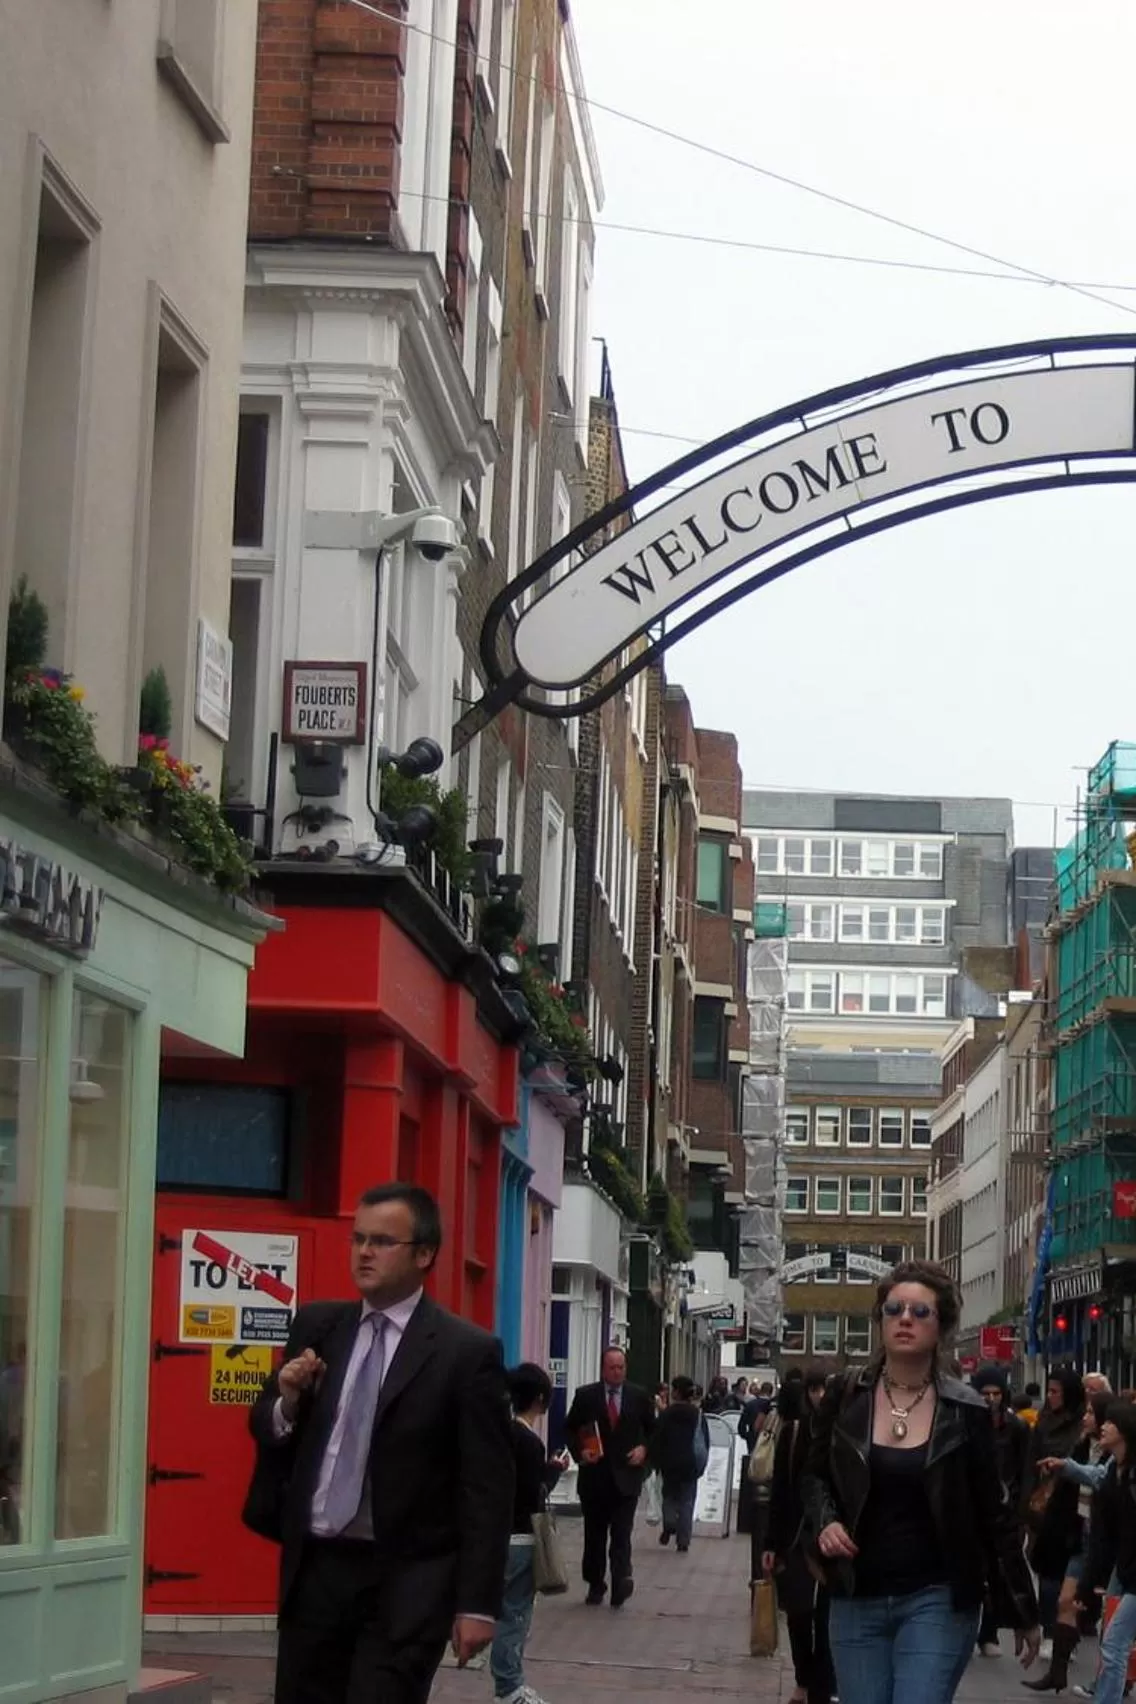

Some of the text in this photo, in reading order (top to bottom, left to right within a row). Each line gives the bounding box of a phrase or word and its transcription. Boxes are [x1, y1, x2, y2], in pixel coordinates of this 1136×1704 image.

[600, 433, 887, 606] WELCOME
[930, 402, 1011, 453] TO
[294, 685, 356, 706] FOUBERTS
[298, 709, 337, 730] PLACE
[189, 1260, 228, 1290] TO
[227, 1252, 262, 1285] LET
[215, 1369, 231, 1384] 24
